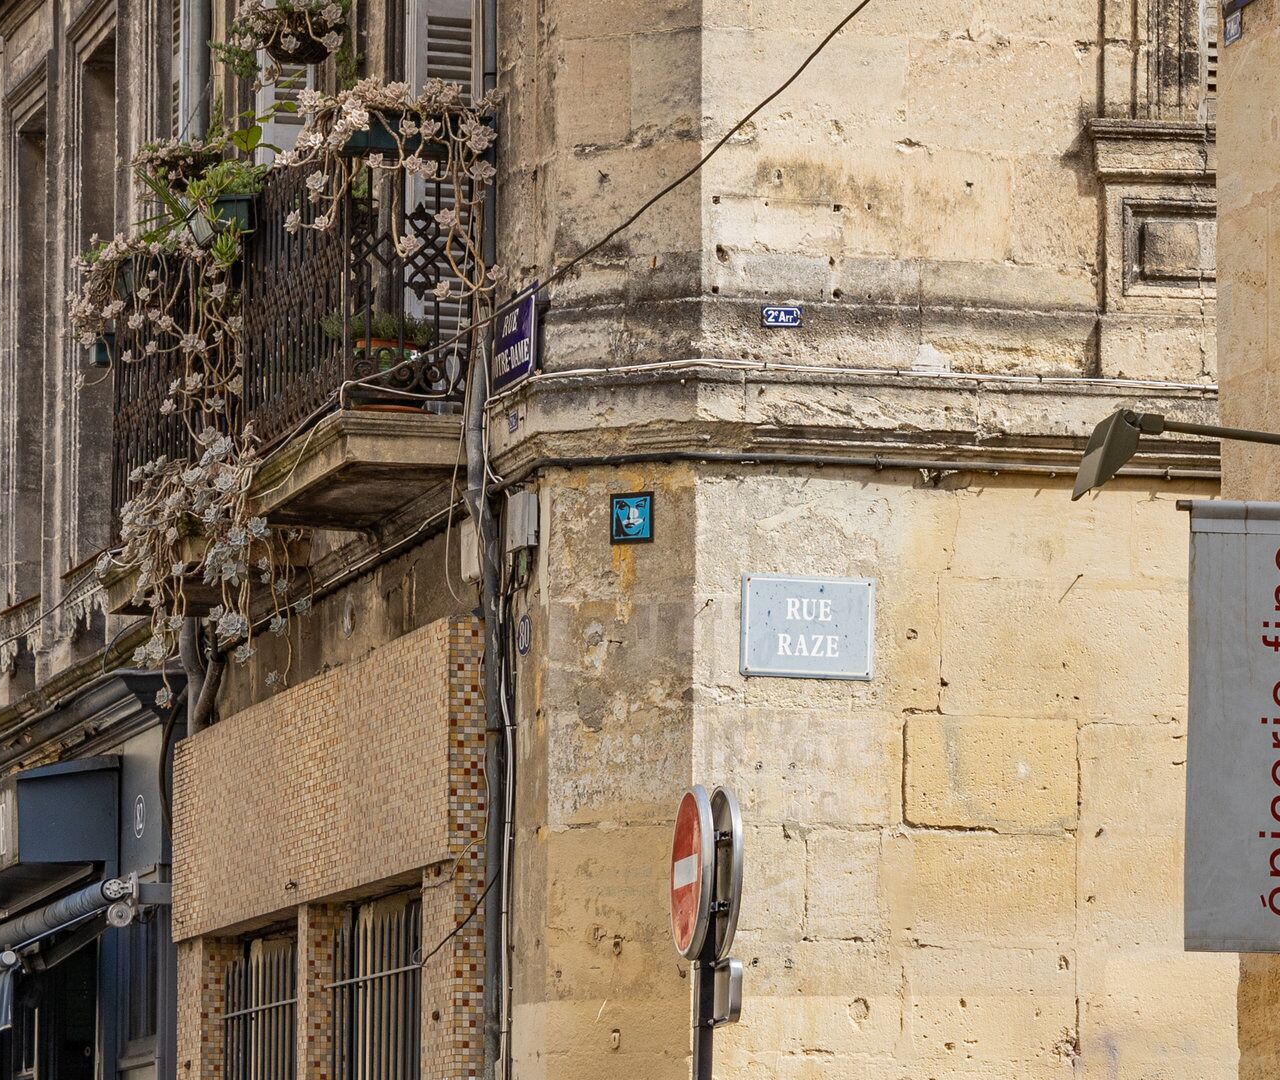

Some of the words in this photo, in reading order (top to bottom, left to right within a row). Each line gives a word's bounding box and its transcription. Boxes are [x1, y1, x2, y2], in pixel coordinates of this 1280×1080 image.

[501, 308, 519, 338] RUE
[785, 597, 833, 622] RUE
[777, 633, 840, 658] RAZE
